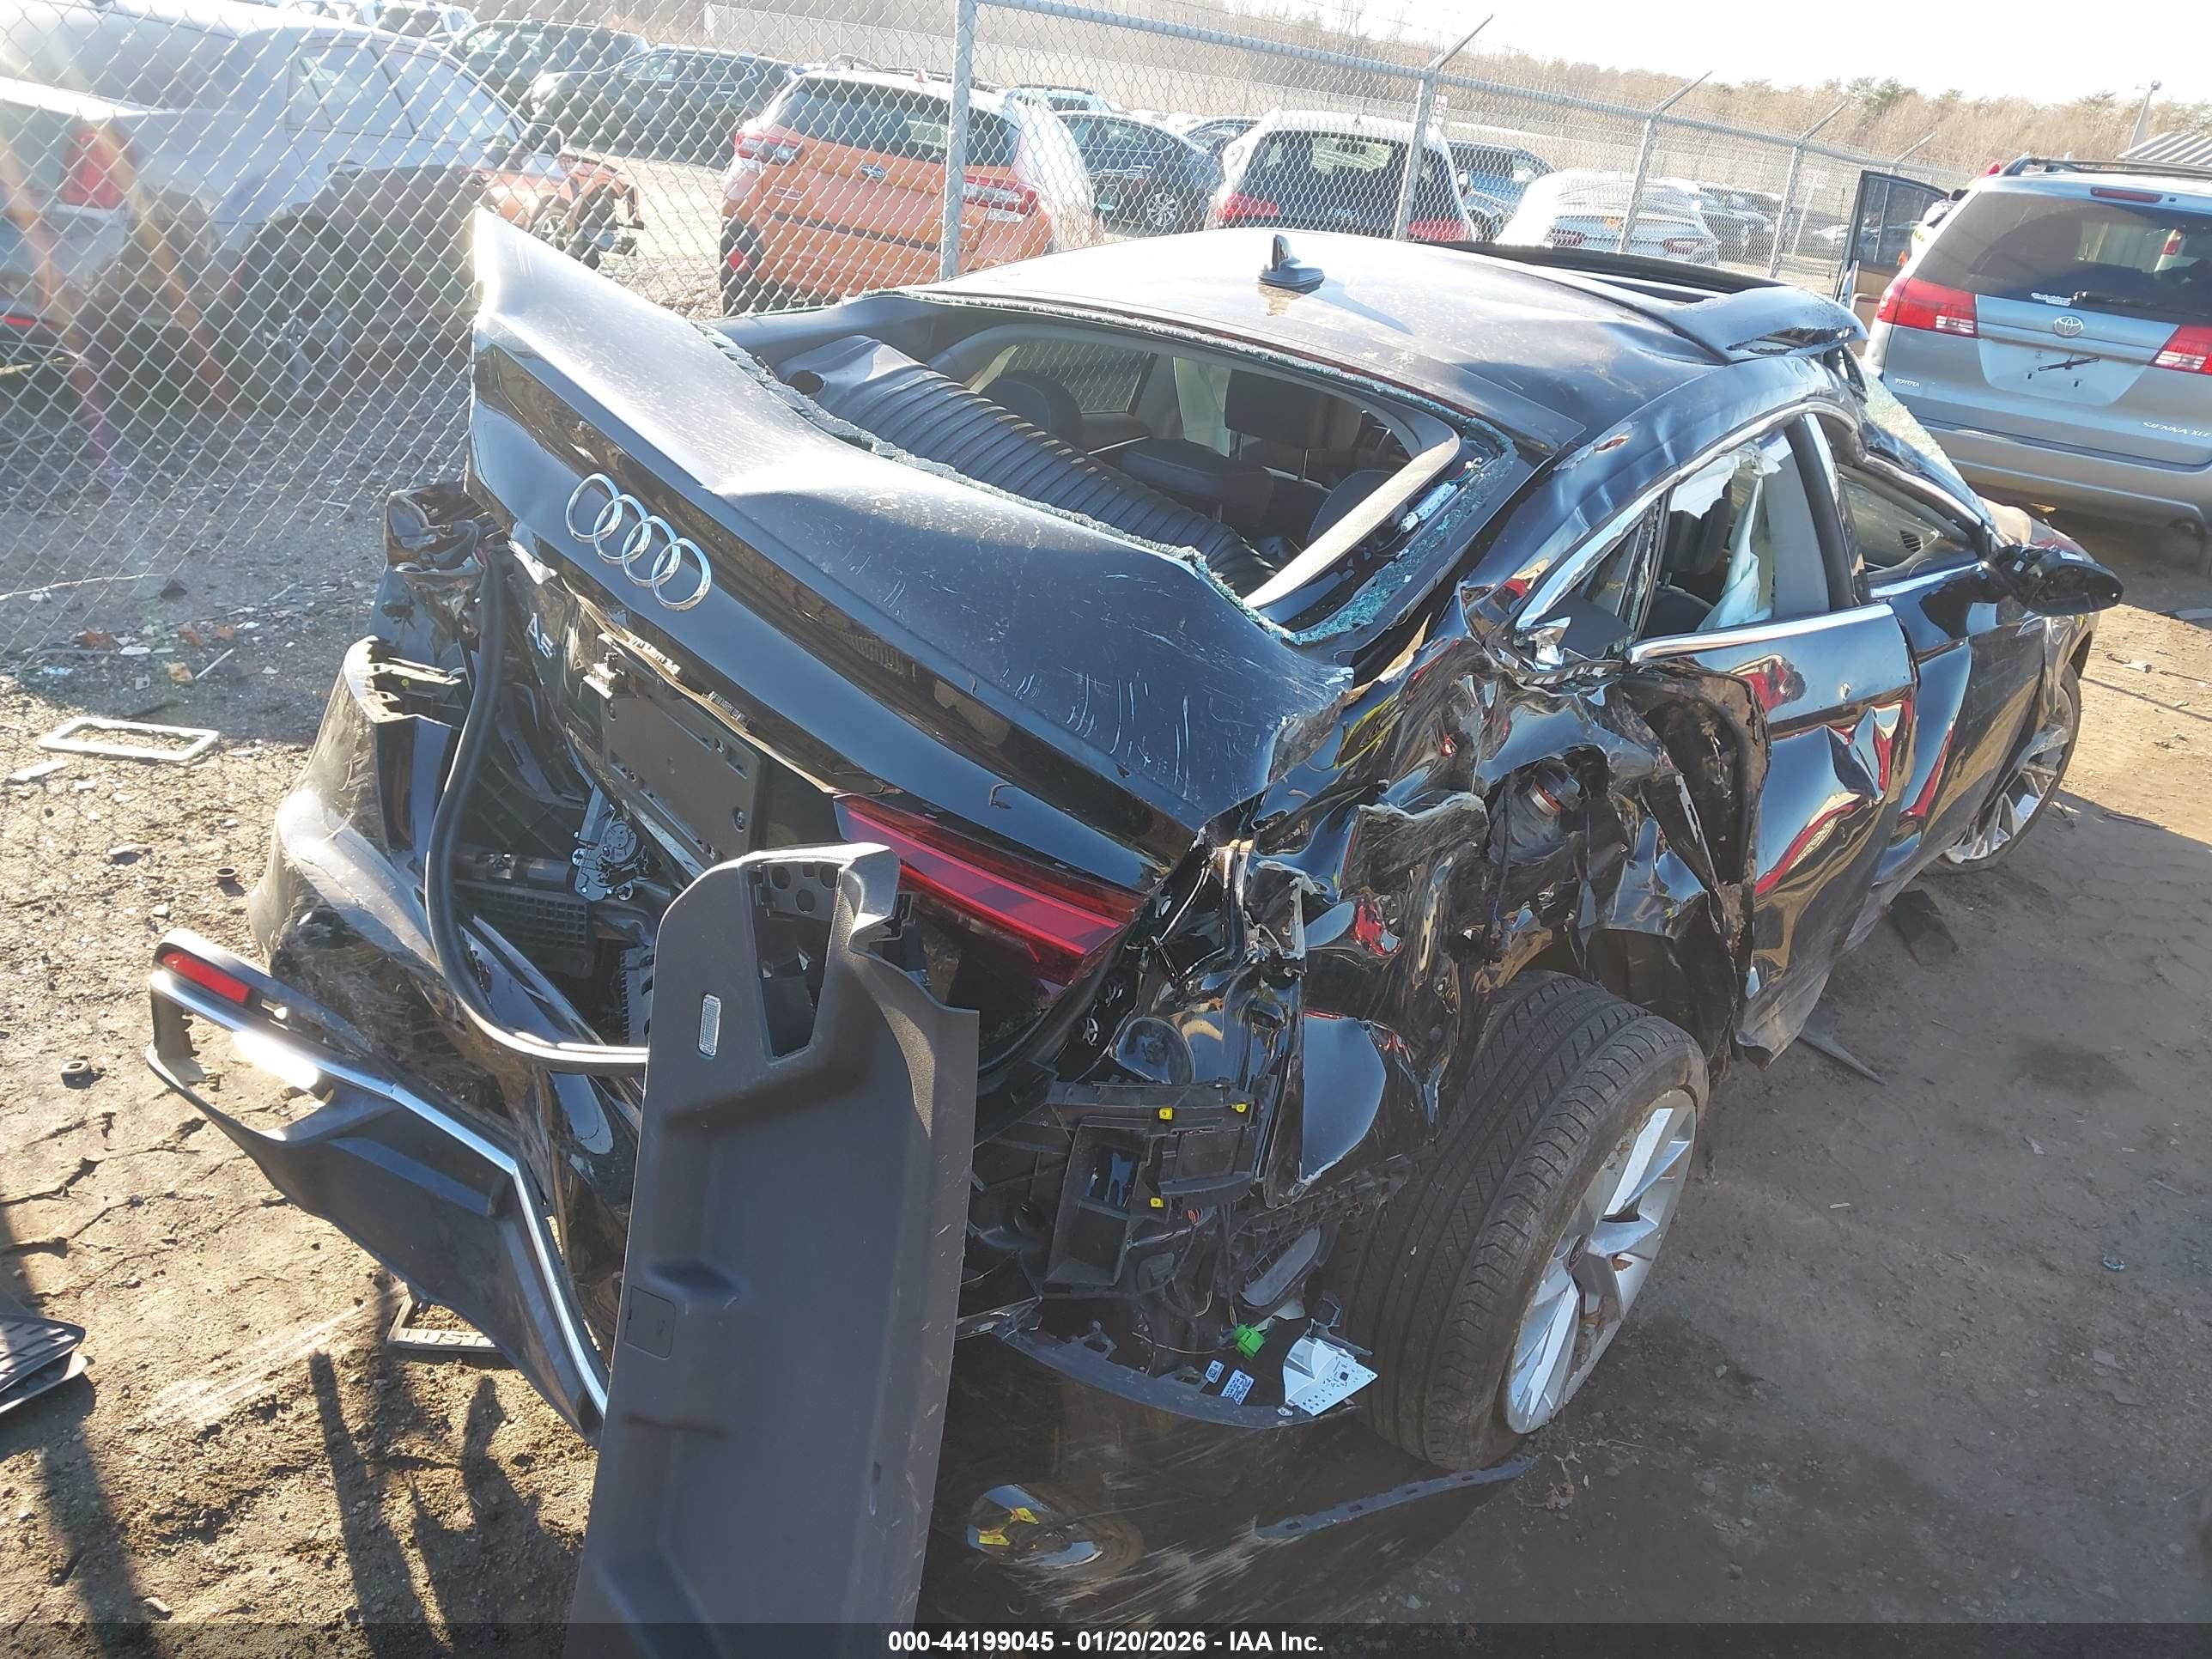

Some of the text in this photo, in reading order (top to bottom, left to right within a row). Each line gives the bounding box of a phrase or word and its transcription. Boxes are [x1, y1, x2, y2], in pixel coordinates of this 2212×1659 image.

[1895, 378, 1920, 387] TOYOTA
[2142, 422, 2188, 434] SIENNA
[526, 611, 555, 659] A5
